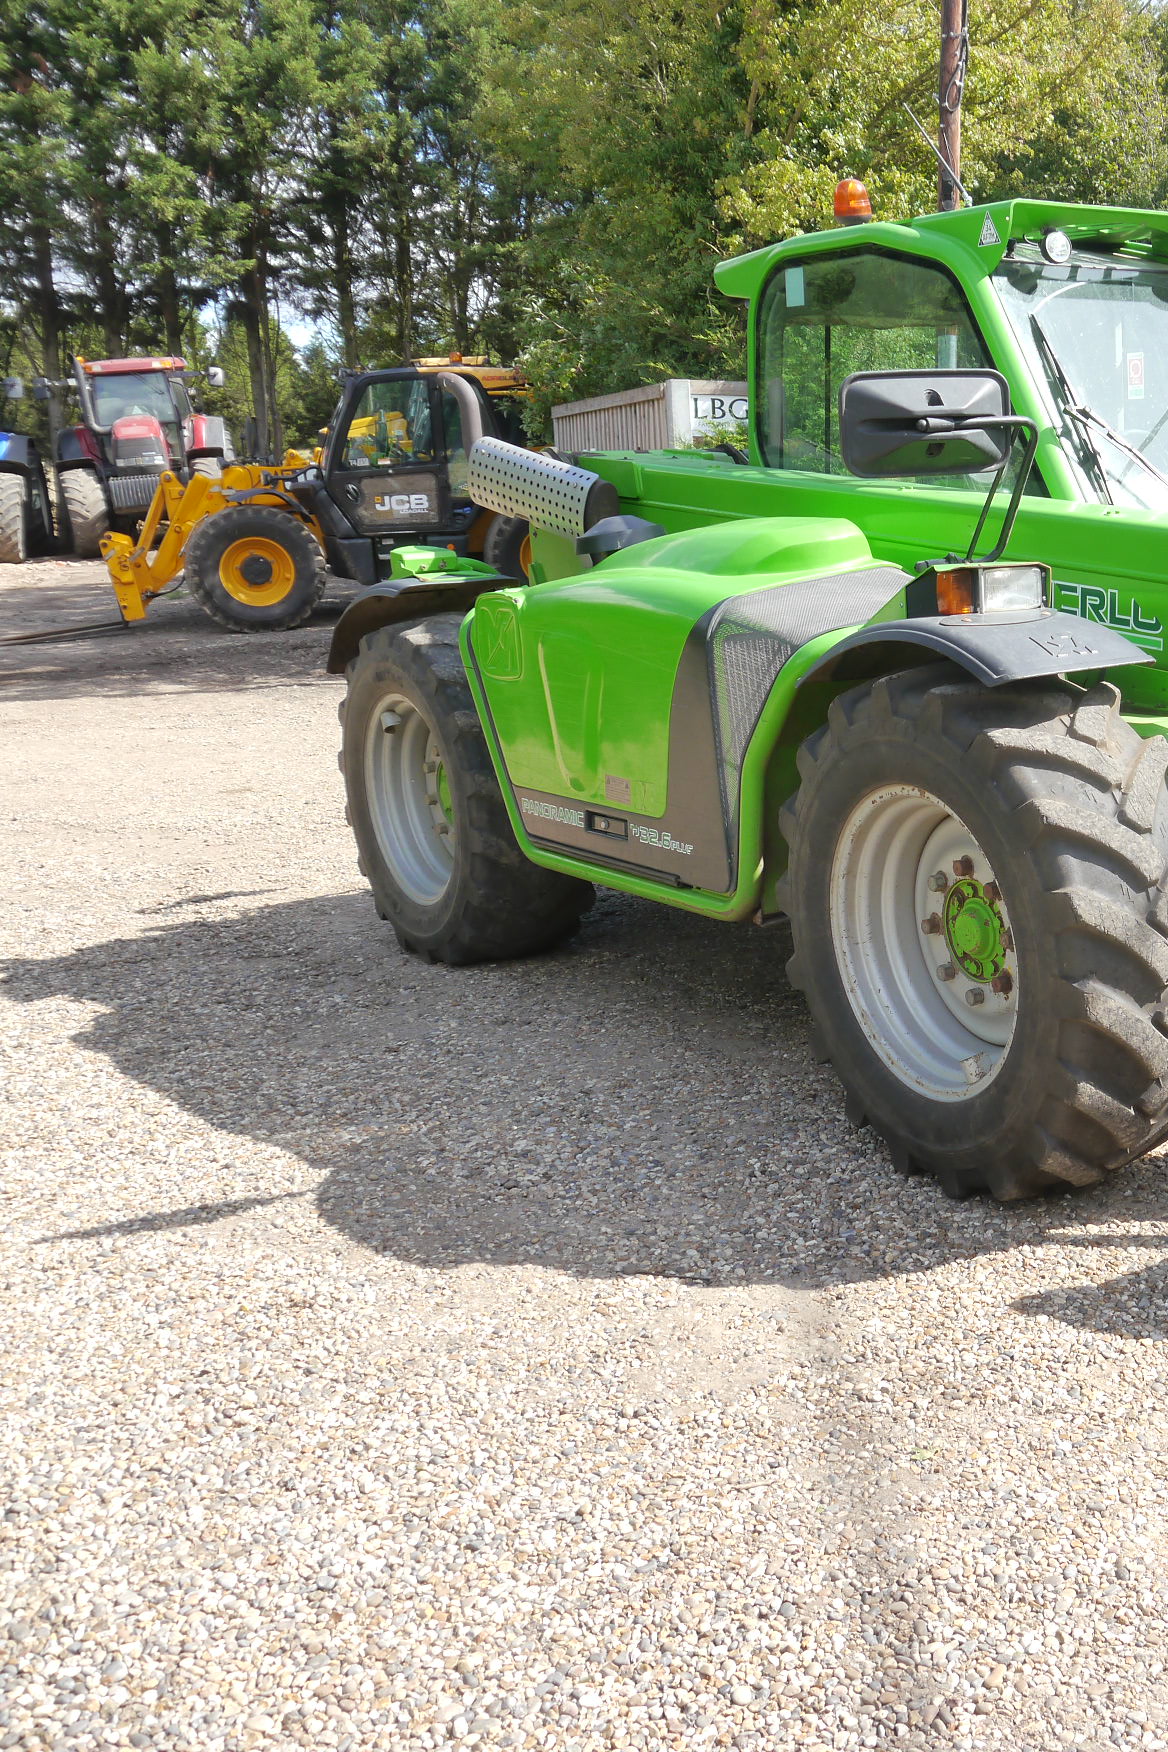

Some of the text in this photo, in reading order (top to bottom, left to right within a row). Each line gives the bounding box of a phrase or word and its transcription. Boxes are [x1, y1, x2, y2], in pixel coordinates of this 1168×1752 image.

[693, 397, 749, 420] LBG
[374, 494, 429, 511] JCB
[521, 797, 585, 828] PANORAMIC
